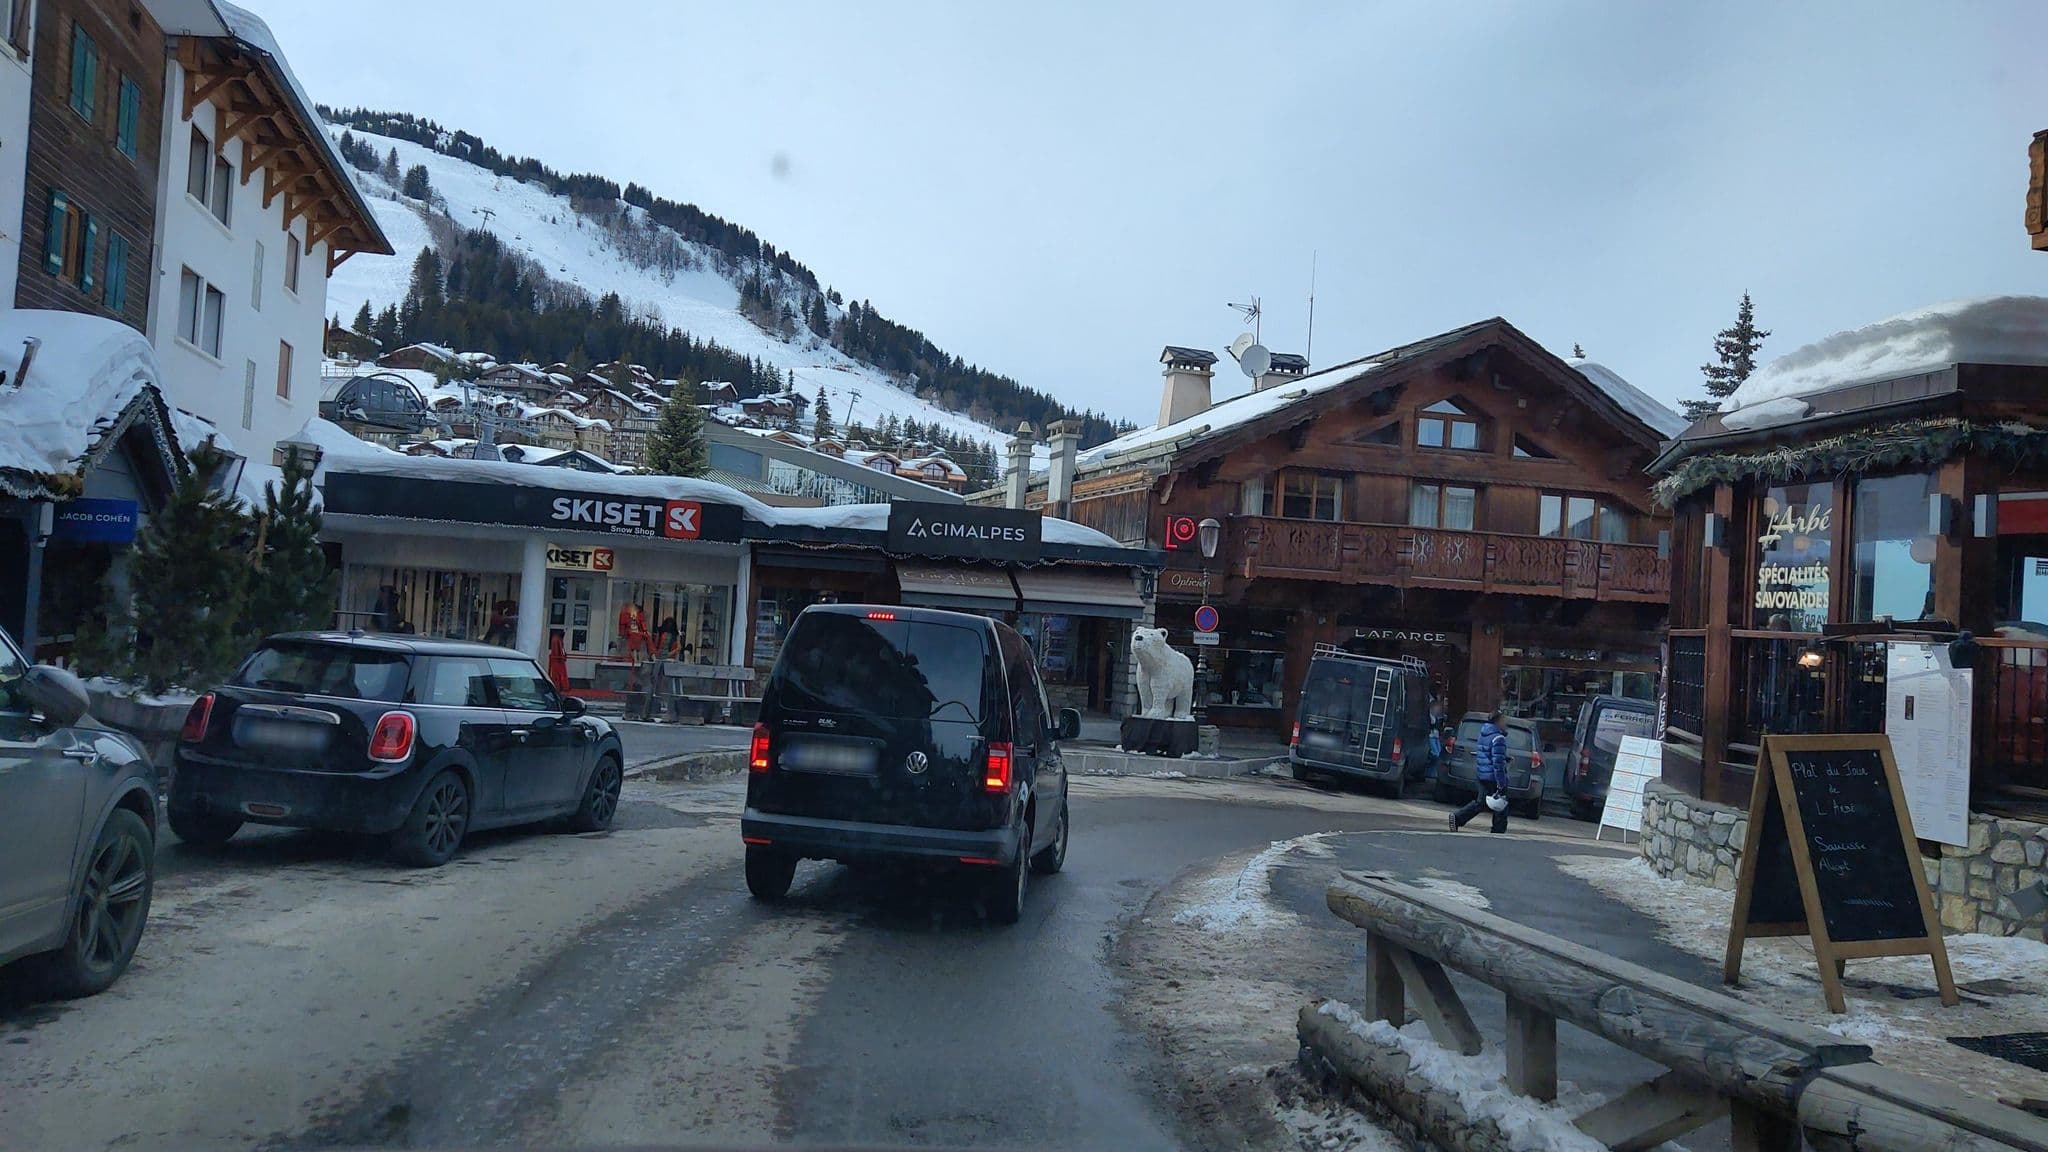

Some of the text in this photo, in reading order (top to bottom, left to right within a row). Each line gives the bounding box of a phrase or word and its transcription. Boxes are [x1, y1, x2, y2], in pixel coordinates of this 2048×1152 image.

[59, 513, 130, 523] JACOB COHEN
[551, 497, 663, 528] SKISET
[610, 525, 655, 536] Snow Shop
[930, 522, 1025, 541] CIMALPES
[547, 549, 593, 564] KISET
[1758, 561, 1830, 585] SPÉCIALITÉS
[1755, 591, 1829, 609] SAVOYARDES
[1791, 762, 1818, 778] Plat
[1825, 762, 1840, 776] du
